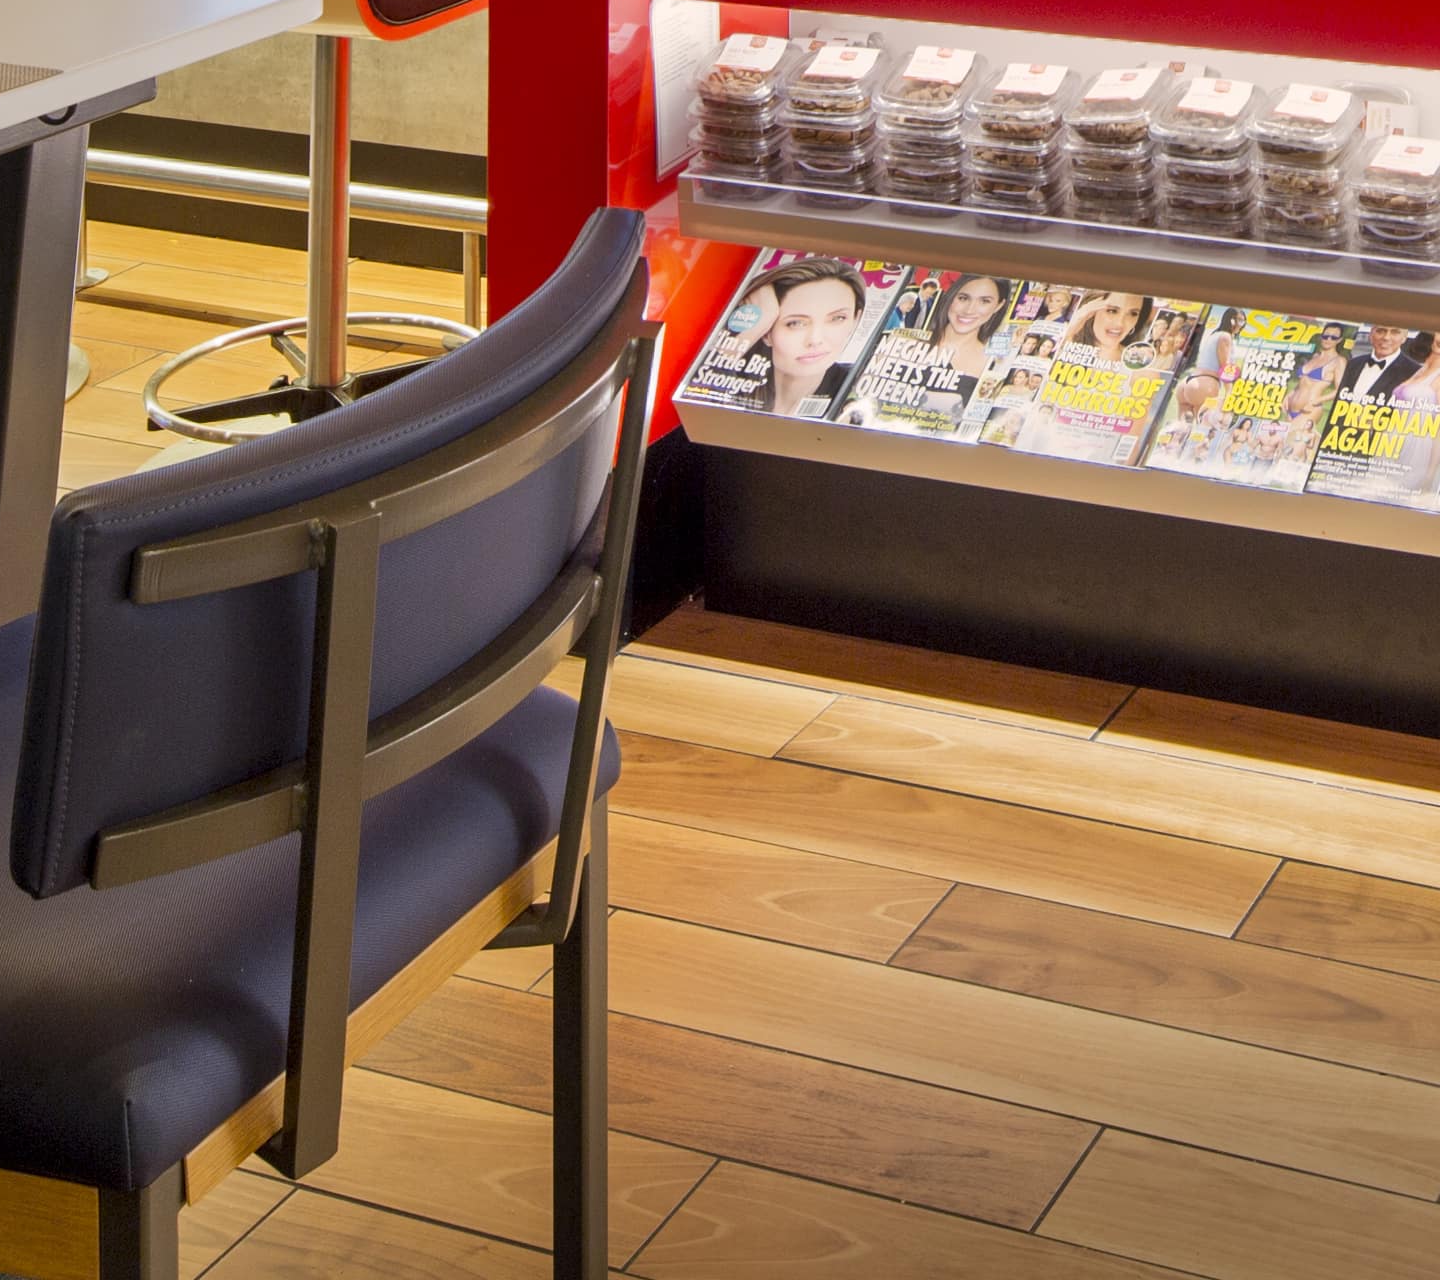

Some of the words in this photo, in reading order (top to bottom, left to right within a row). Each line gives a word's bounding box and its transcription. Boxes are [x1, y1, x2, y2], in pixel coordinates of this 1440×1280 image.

[1239, 311, 1323, 345] Star
[876, 337, 955, 367] MEGHAN
[865, 357, 932, 383] MEETS
[930, 366, 962, 390] THE
[1050, 362, 1130, 395] HOUSE
[1132, 377, 1165, 396] OF
[1232, 378, 1286, 402] BEACH
[855, 375, 922, 406] QUEEN!
[1042, 384, 1149, 419] HORRORS
[1223, 393, 1282, 420] BODIES
[1322, 426, 1404, 459] AGAIN!
